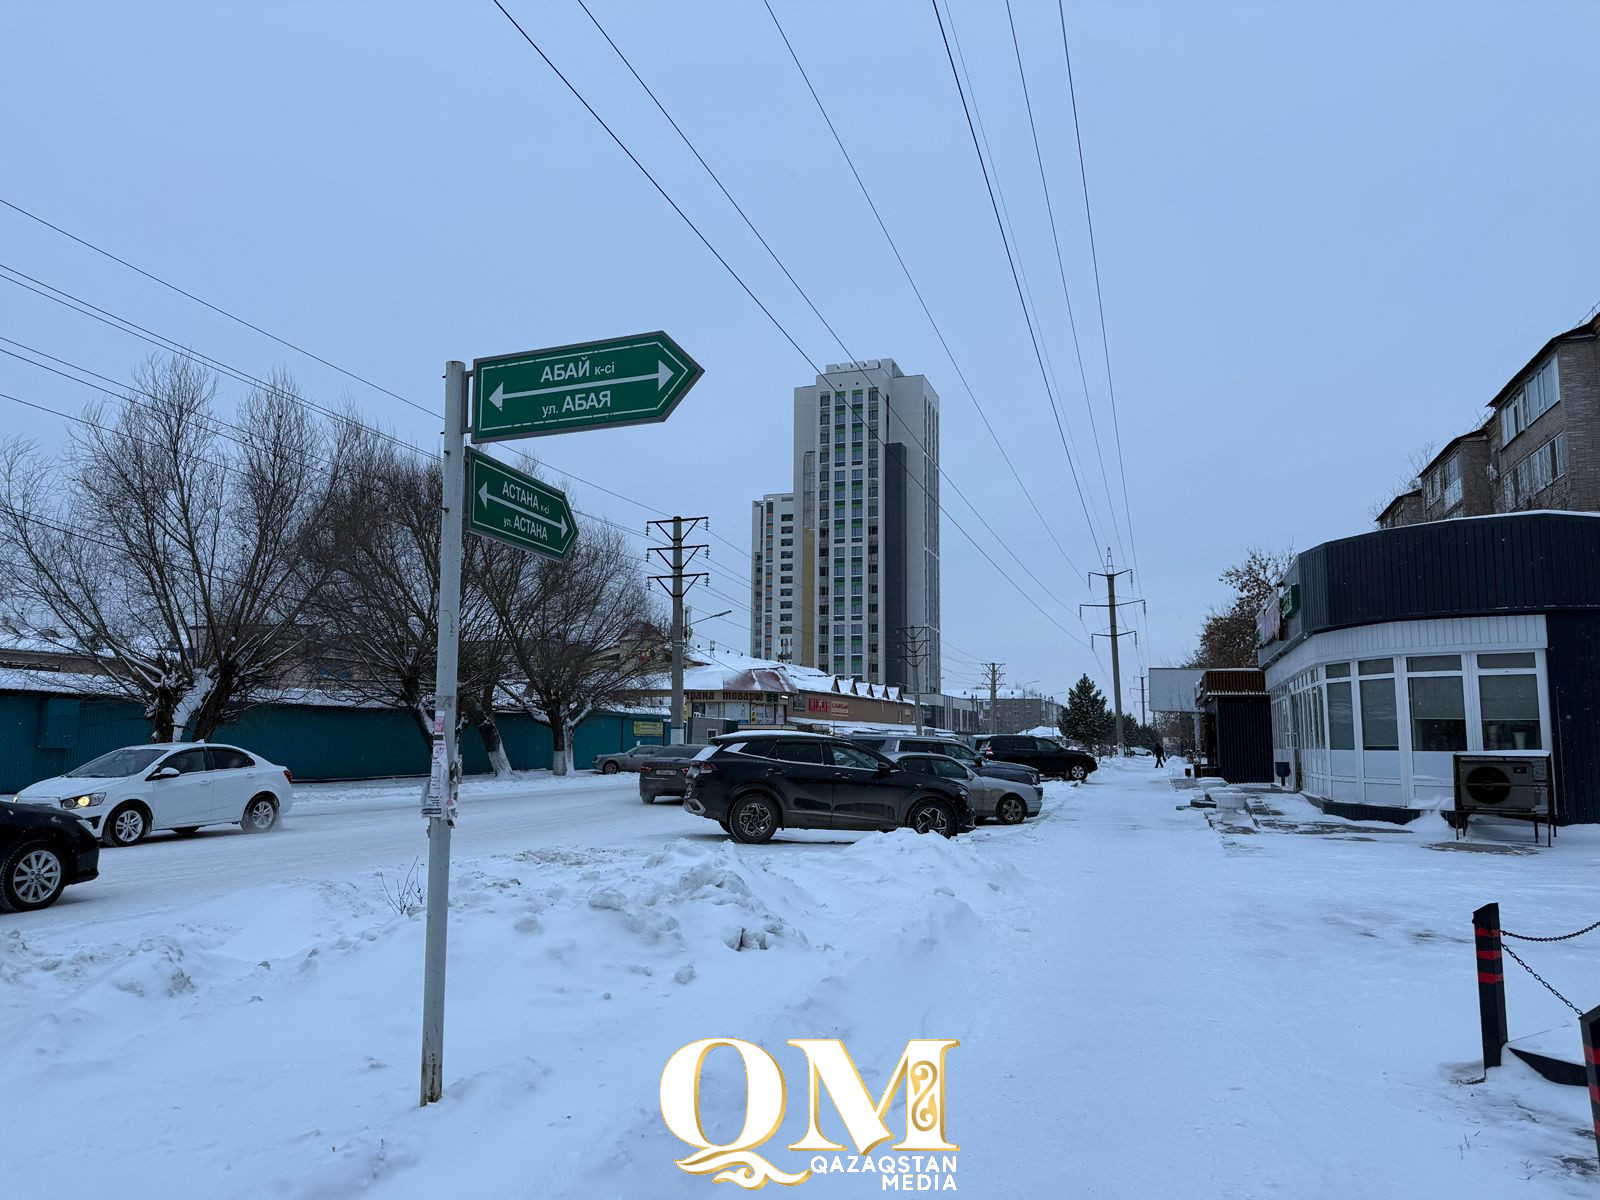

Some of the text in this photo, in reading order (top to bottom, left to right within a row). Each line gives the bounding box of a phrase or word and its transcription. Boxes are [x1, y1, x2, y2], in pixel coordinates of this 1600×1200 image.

[540, 356, 615, 383] АБАЙ к-сі
[542, 390, 611, 418] ул. АБАЯ
[502, 481, 539, 510] АСТАНА
[503, 515, 548, 541] ул. АСТАНА
